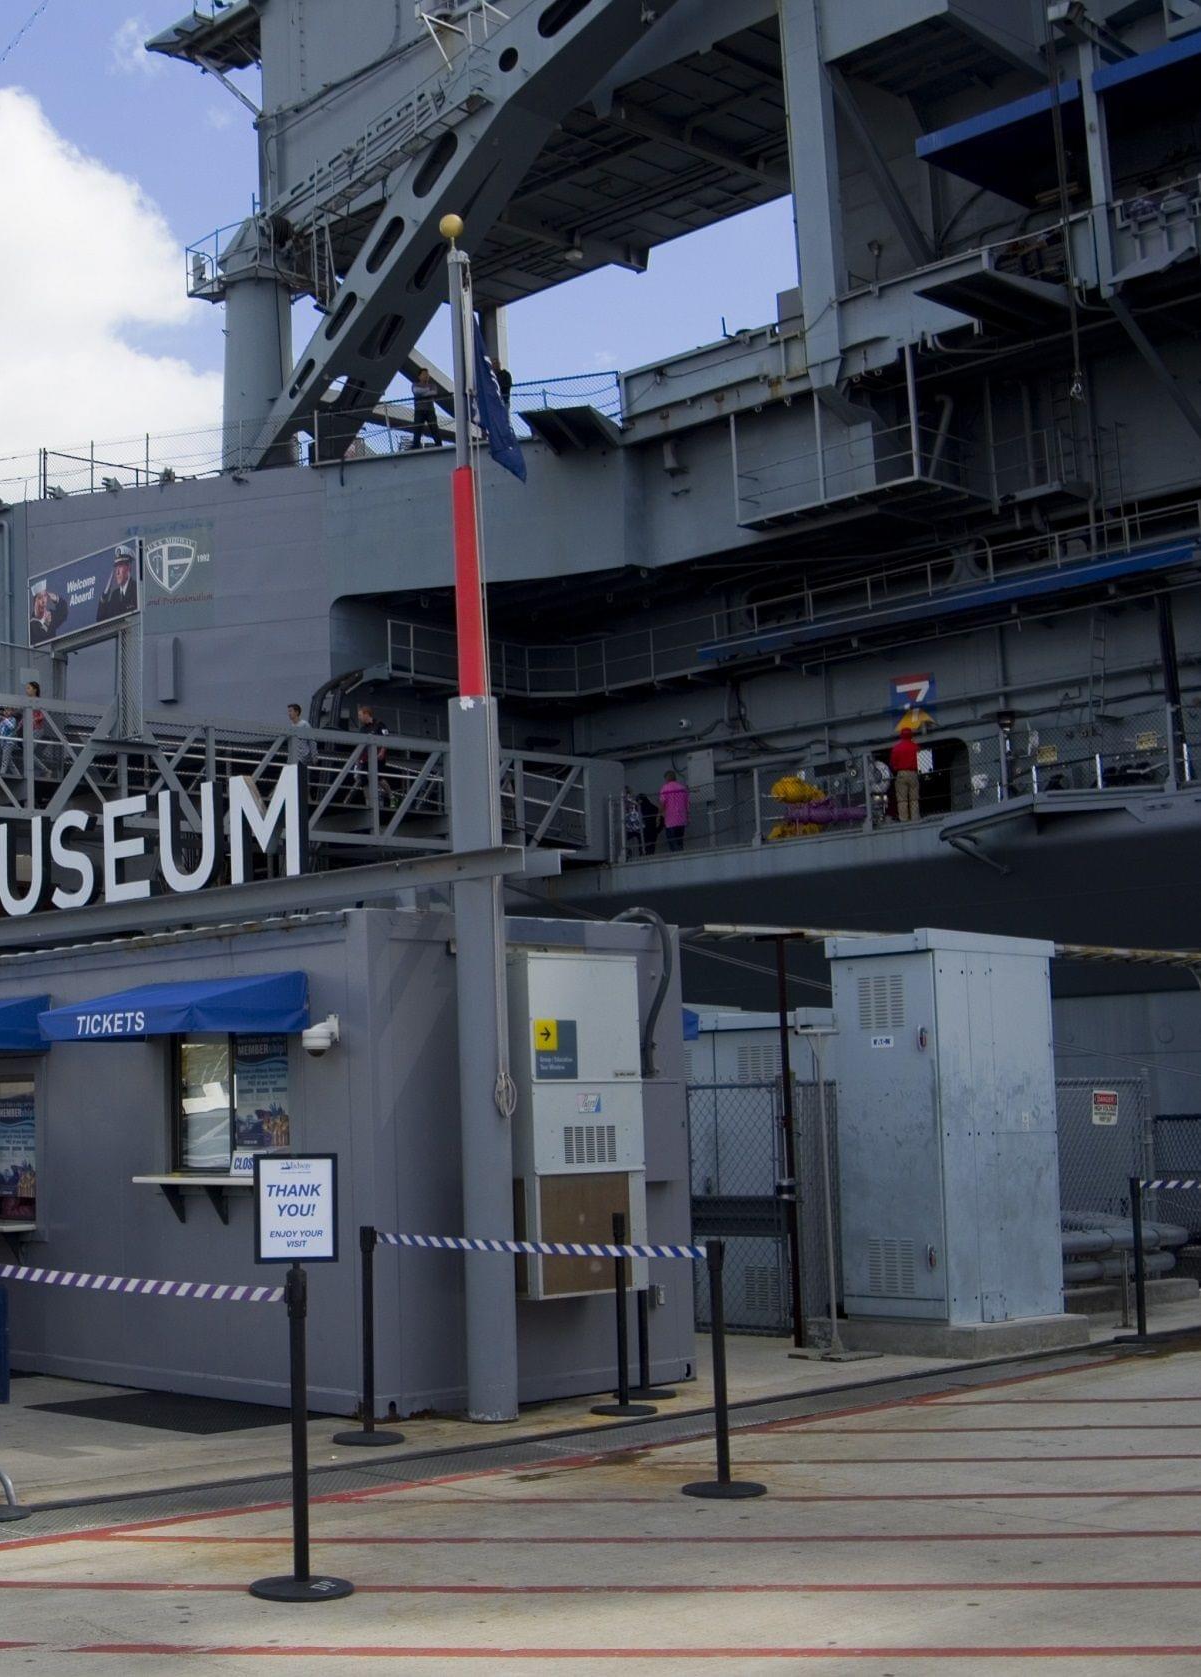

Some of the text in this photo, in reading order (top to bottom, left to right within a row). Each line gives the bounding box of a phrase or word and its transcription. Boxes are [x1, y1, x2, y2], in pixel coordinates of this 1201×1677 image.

[67, 576, 96, 593] Welcome
[69, 587, 95, 607] Aboard!
[76, 1010, 146, 1036] TICKETS
[266, 1184, 323, 1197] THANK
[277, 1204, 316, 1217] YOU!
[269, 1229, 323, 1238] ENJOY YOUR
[286, 1240, 307, 1248] VISIT
